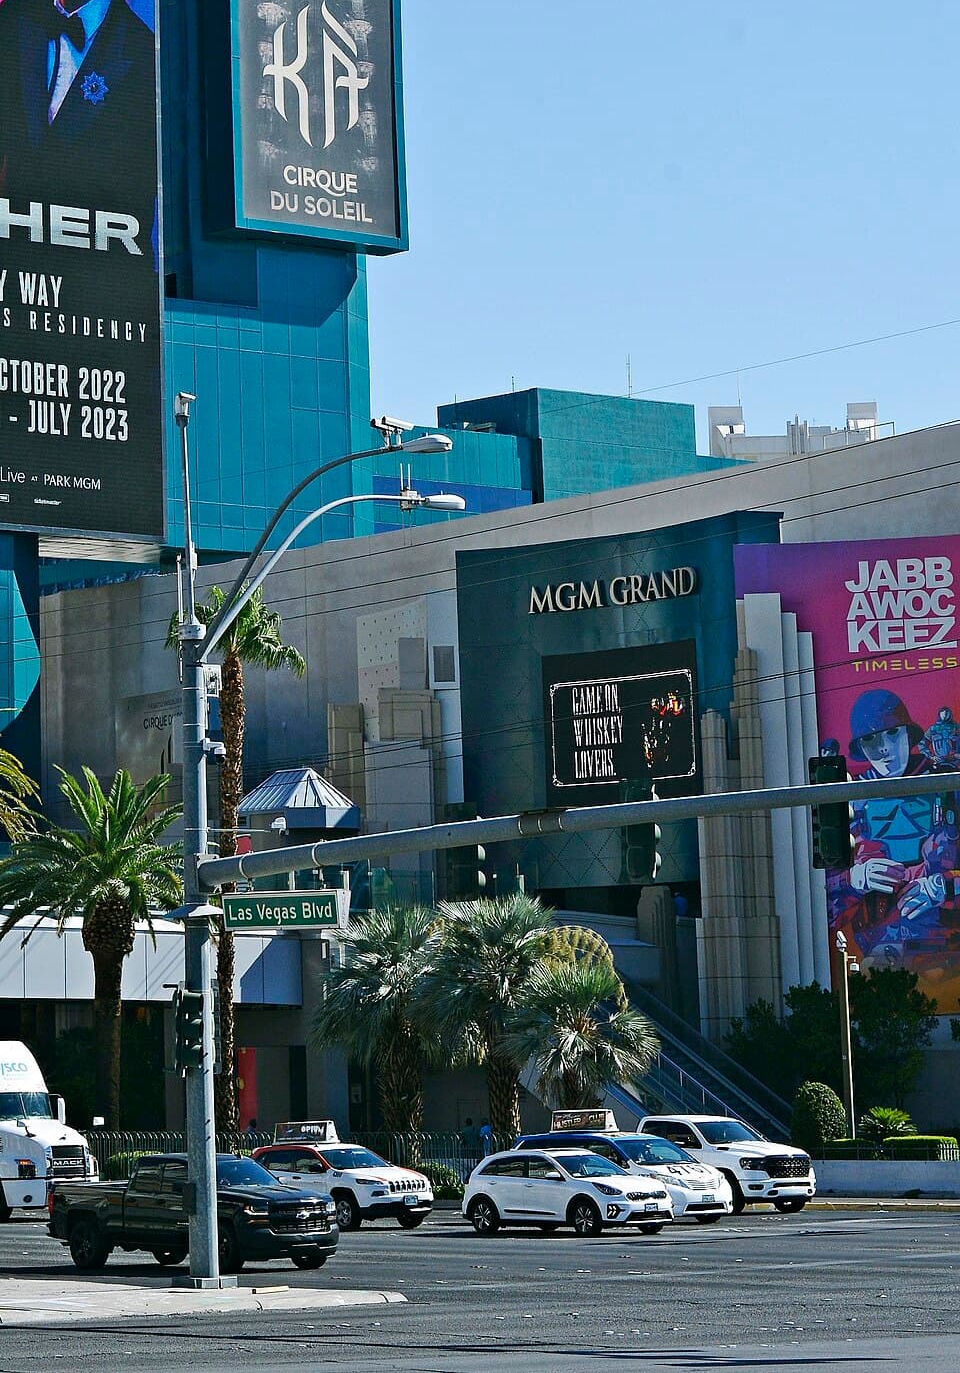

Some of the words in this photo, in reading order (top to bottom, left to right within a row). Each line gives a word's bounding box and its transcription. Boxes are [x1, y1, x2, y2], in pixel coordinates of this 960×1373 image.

[283, 165, 358, 197] CIRQUE
[270, 190, 299, 214] DU
[304, 196, 374, 223] SOLEIL
[18, 271, 63, 308] WAY
[29, 310, 147, 343] RESIDENCY
[78, 367, 126, 404] 2022
[27, 399, 72, 436] JULY
[81, 405, 129, 442] 2023
[0, 466, 26, 484] Live
[44, 473, 71, 488] PARK
[73, 476, 101, 491] MGM
[528, 579, 603, 614] MGM
[609, 566, 696, 606] GRAND
[844, 556, 954, 593] JABB
[846, 588, 956, 621] AWOC
[847, 617, 958, 653] KEEZ
[851, 657, 958, 672] TIMELESS
[572, 686, 603, 716] GAME
[143, 715, 167, 731] CIRQUE
[573, 715, 623, 747] WHISKEY
[574, 748, 617, 779] LOVERS.
[228, 904, 253, 921] Las
[257, 903, 297, 925] Vegas
[302, 901, 333, 919] Blvd
[53, 1159, 83, 1167] MACK
